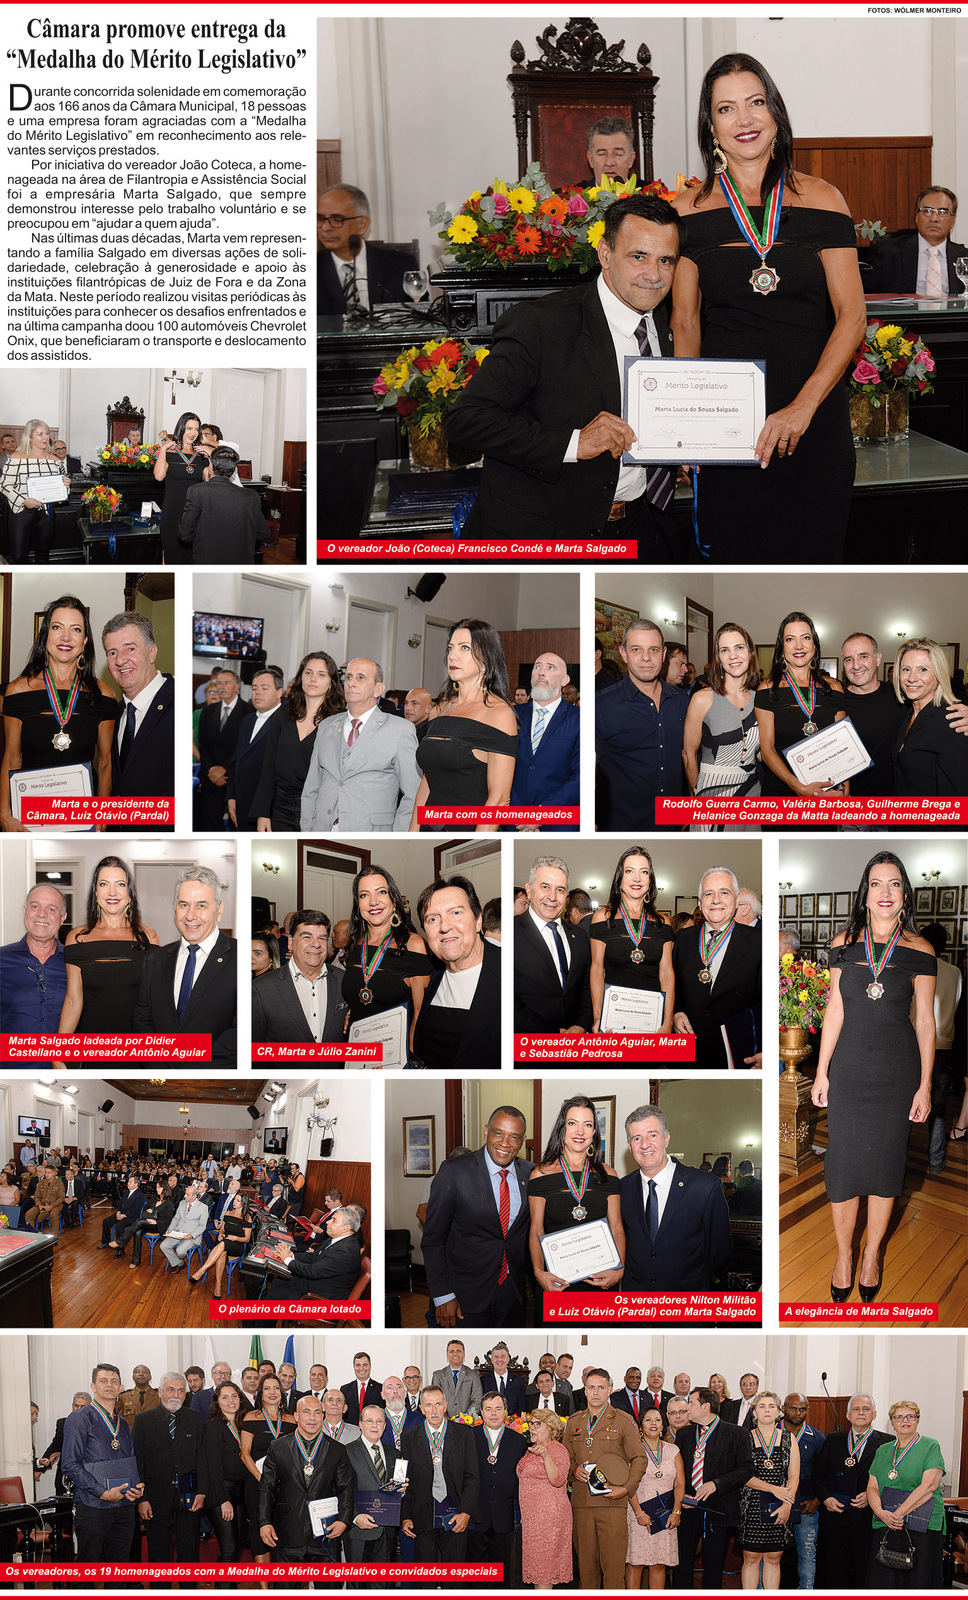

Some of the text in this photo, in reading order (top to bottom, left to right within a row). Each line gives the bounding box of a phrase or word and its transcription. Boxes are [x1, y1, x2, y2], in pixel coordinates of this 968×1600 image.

[691, 382, 728, 390] Legislativo
[716, 406, 739, 414] Salgado
[45, 780, 67, 788] Legislativo
